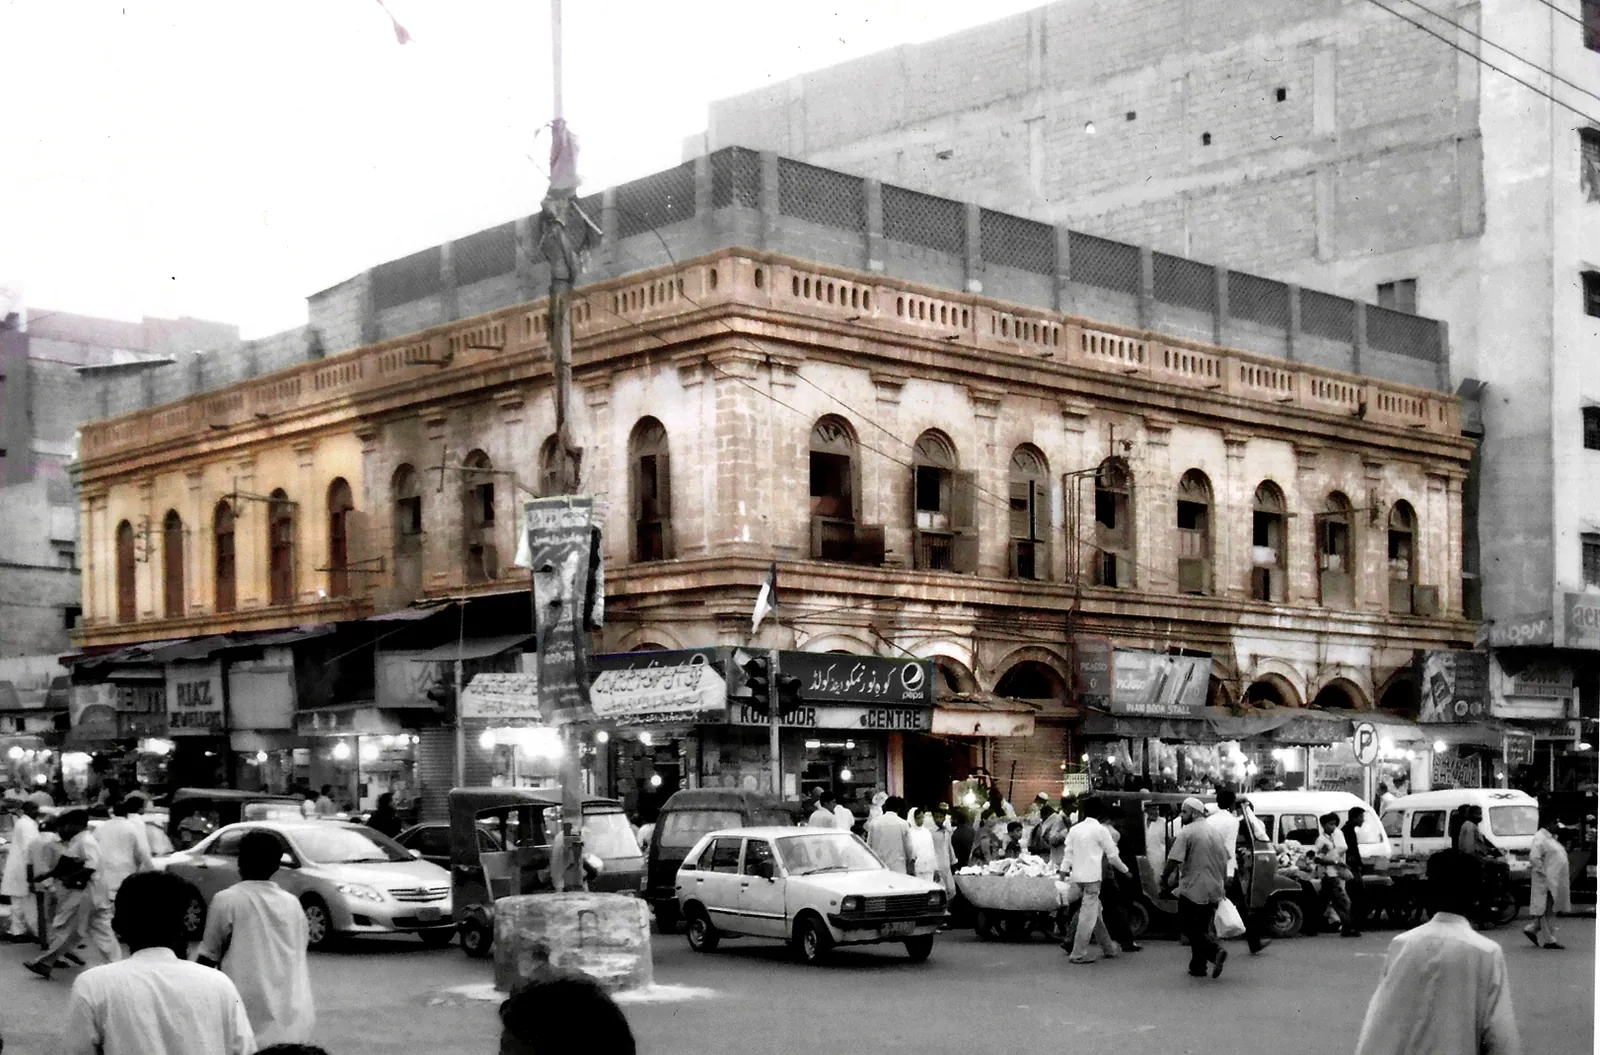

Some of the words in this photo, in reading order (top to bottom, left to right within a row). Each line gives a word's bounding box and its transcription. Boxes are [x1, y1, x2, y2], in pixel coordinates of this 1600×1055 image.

[177, 680, 213, 706] RIAZ
[902, 691, 924, 700] pepsi
[868, 709, 921, 728] CENTRE
[1146, 704, 1166, 714] BOOK
[1167, 704, 1191, 714] STALL
[1360, 730, 1372, 759] P
